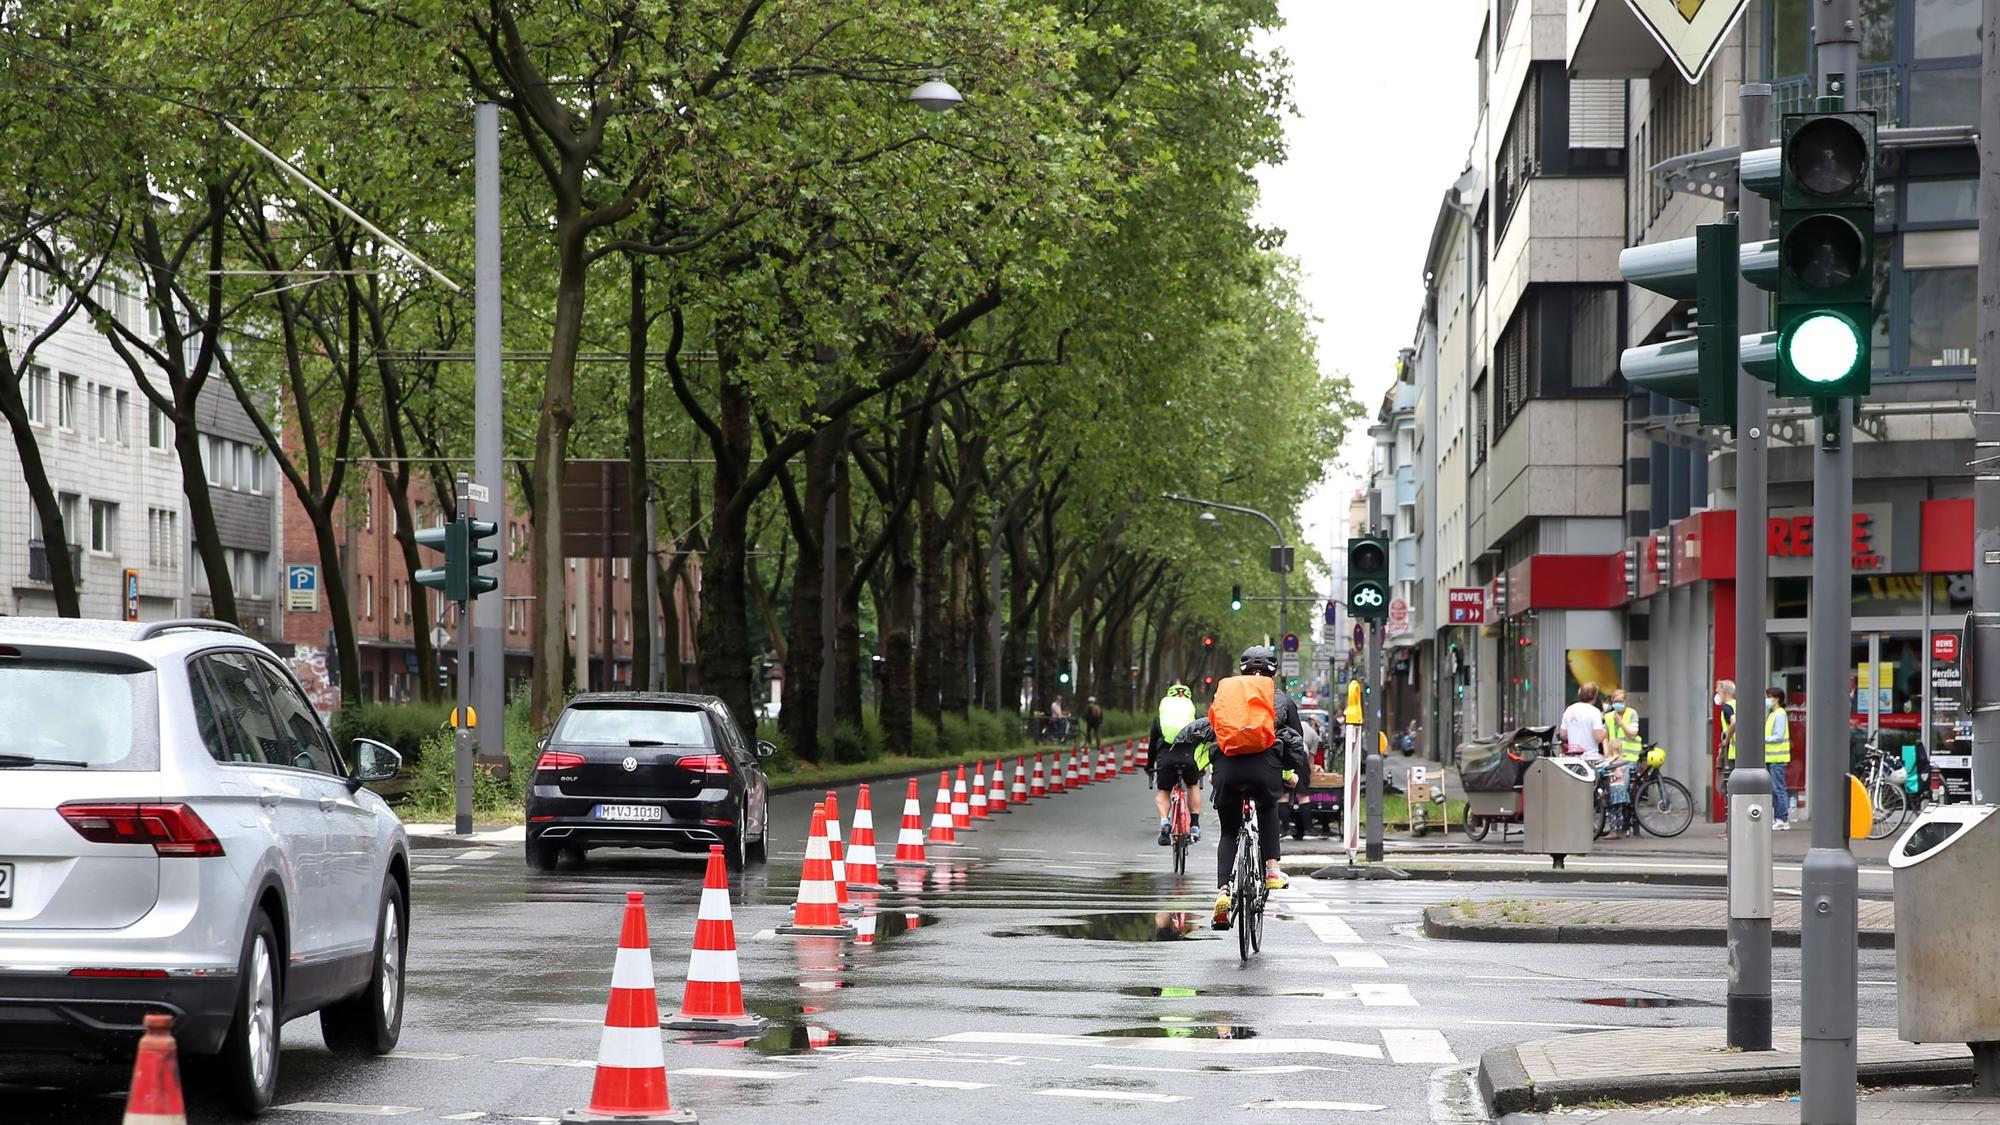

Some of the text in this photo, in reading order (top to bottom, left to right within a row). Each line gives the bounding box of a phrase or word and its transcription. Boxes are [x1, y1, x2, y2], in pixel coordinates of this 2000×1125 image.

[1767, 513, 1870, 557] REE
[298, 574, 308, 588] P
[1451, 592, 1480, 602] REWE
[1456, 608, 1463, 620] P
[1932, 669, 1959, 678] Herzlich
[602, 806, 610, 816] M
